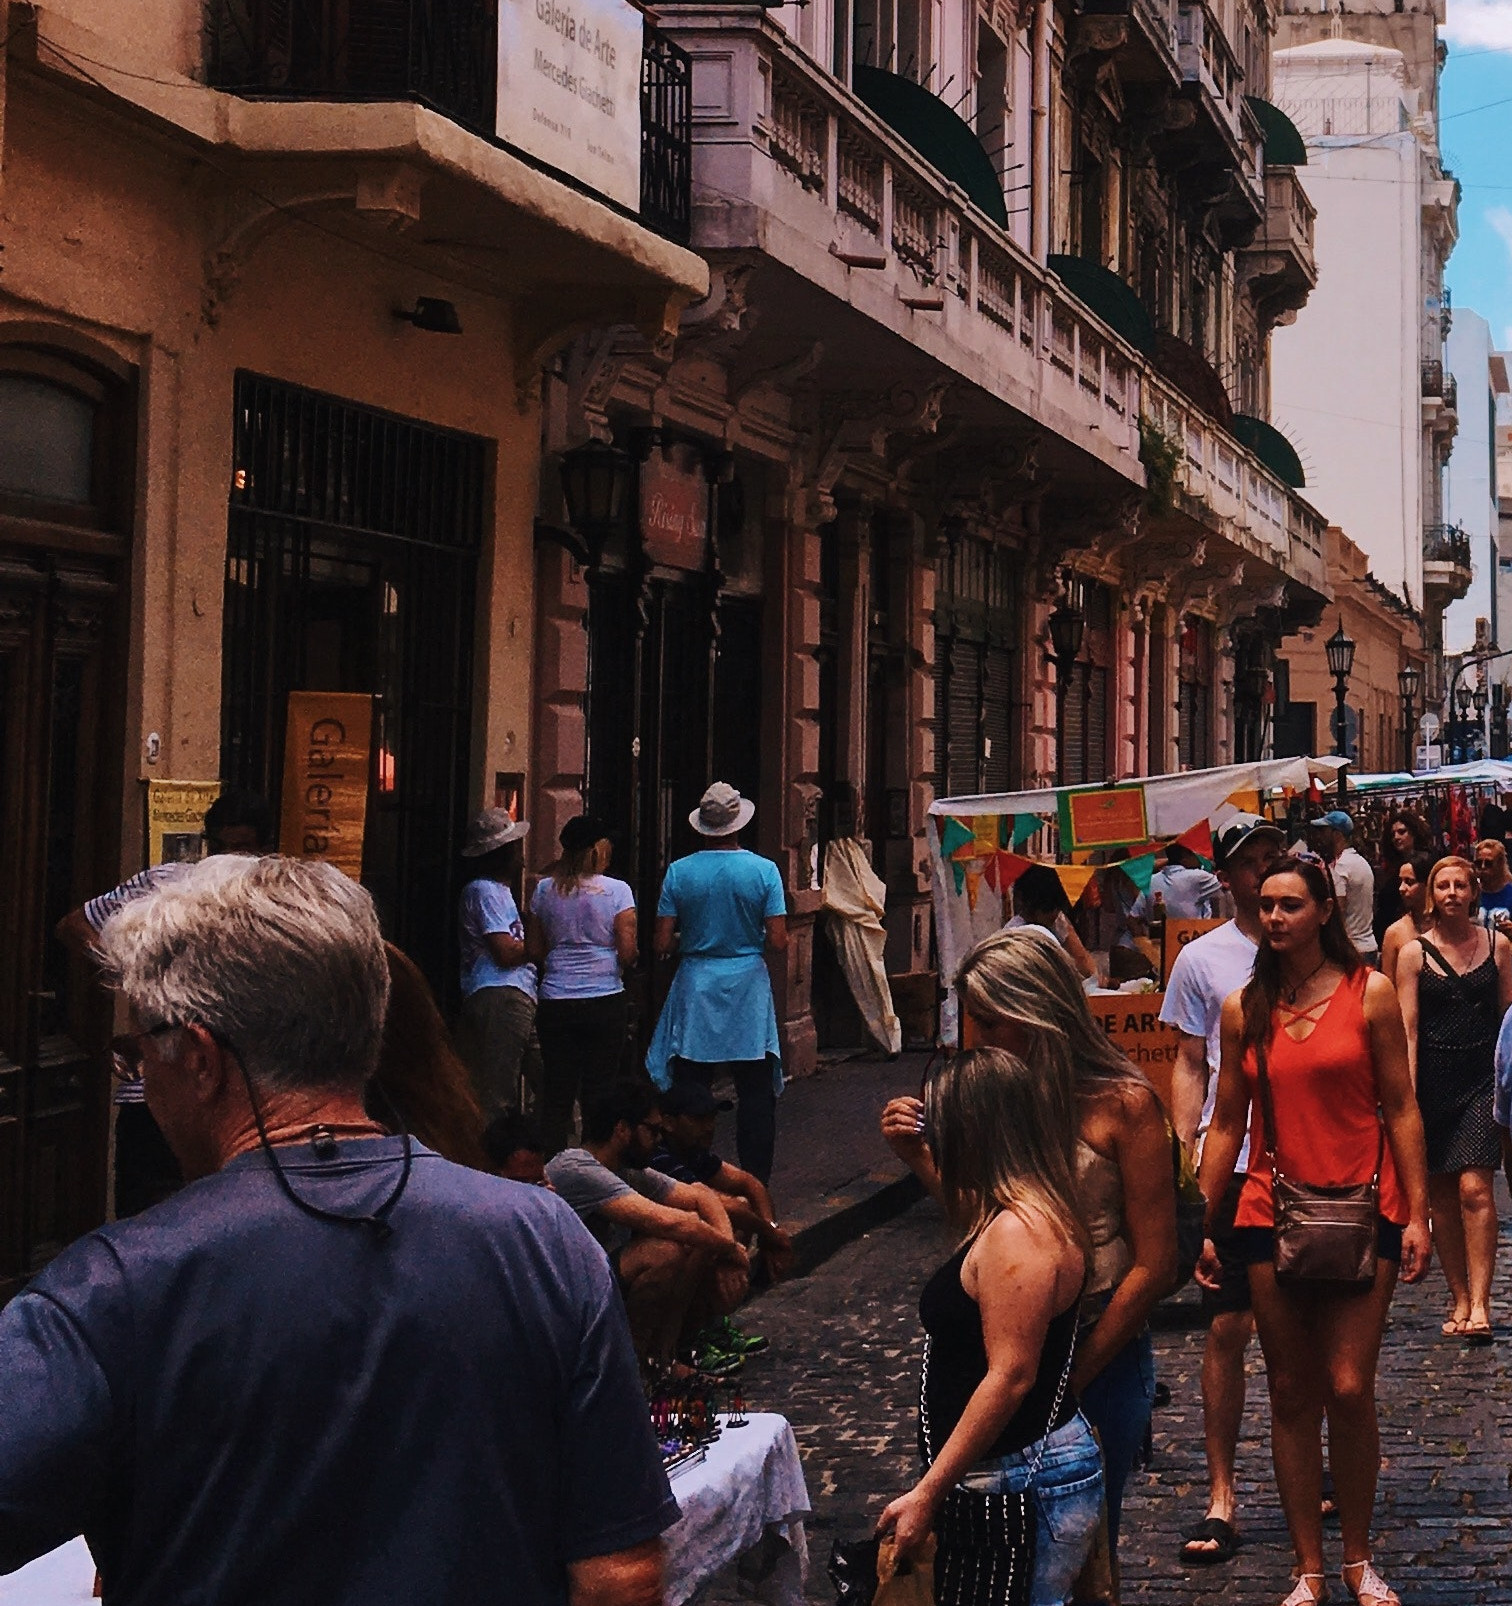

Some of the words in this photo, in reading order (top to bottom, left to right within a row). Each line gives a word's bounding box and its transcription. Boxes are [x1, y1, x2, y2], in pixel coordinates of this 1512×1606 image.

[578, 17, 593, 55] de
[594, 28, 617, 70] Arte
[533, 47, 578, 95] Mercedes
[304, 717, 346, 854] Galería
[1123, 1012, 1180, 1033] ART
[1125, 1043, 1179, 1062] chett
